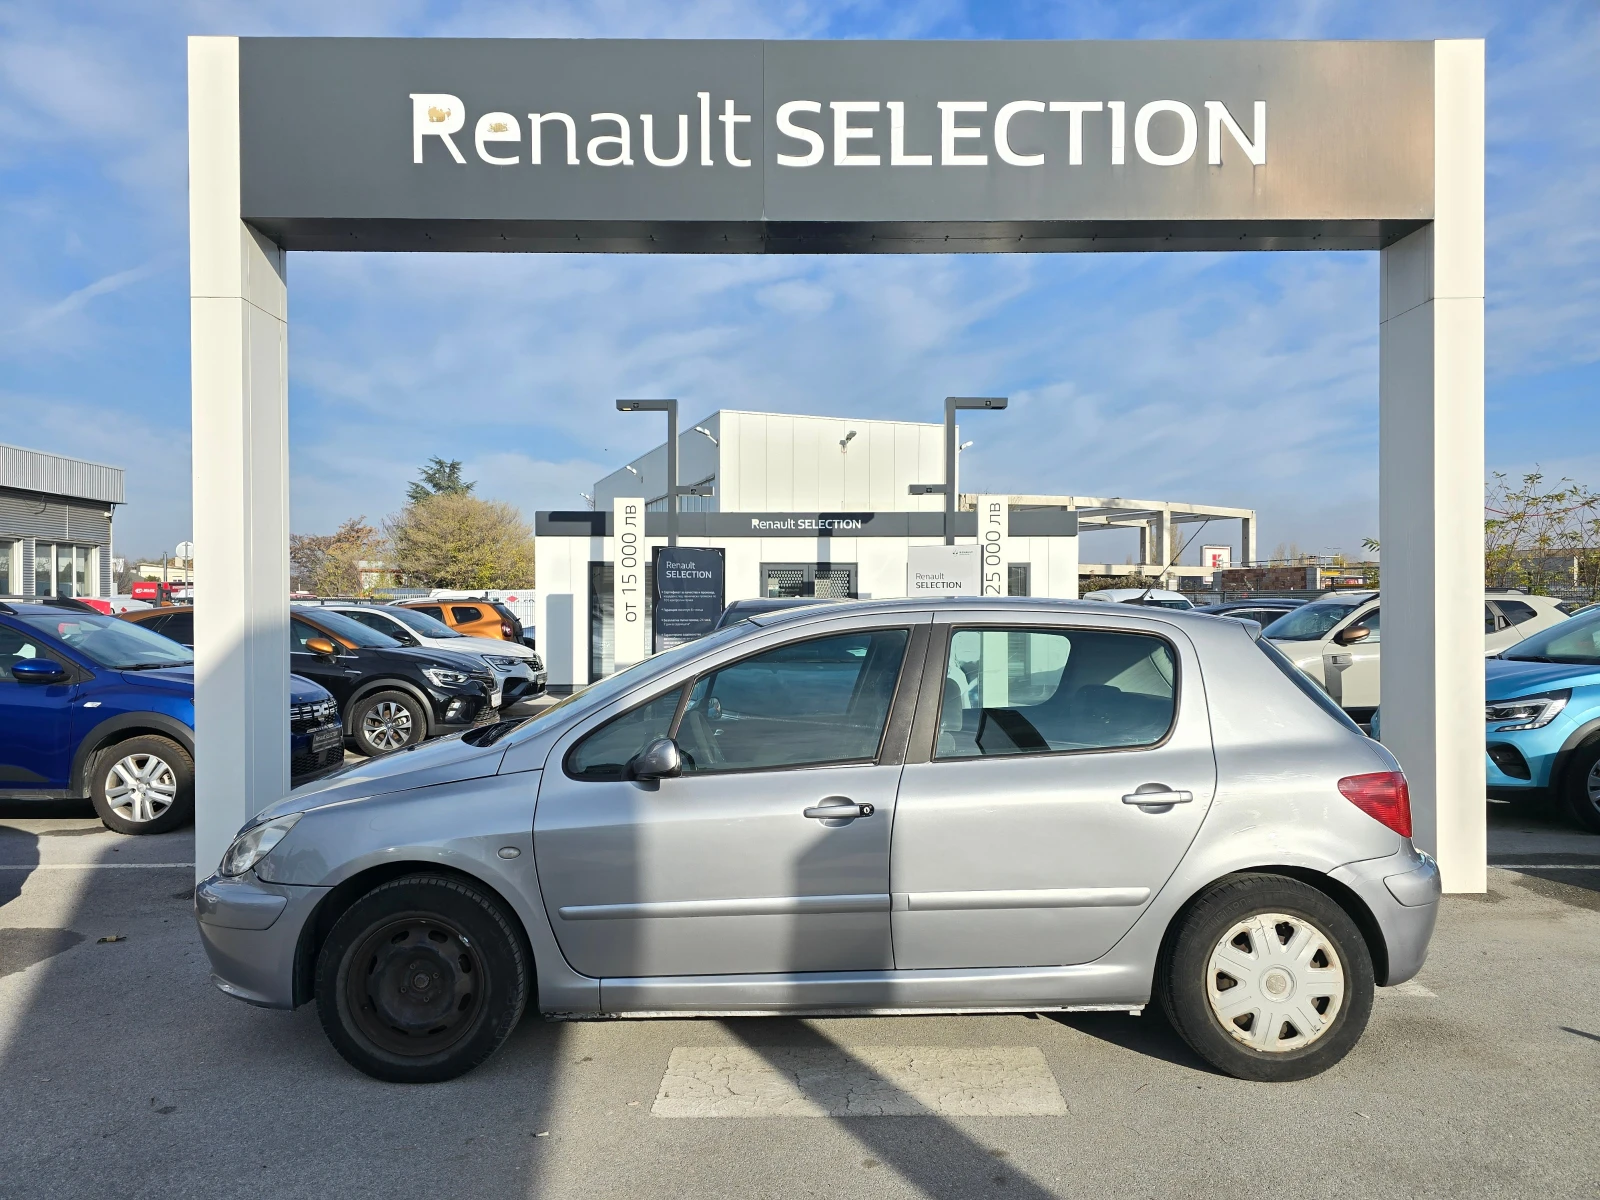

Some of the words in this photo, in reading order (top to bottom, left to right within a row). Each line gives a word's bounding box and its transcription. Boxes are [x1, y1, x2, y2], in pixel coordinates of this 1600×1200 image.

[409, 91, 751, 167] Renault
[775, 100, 1266, 167] SELECTION
[751, 518, 796, 529] Renault
[797, 519, 862, 529] SELECTION
[622, 533, 637, 568] 000
[985, 530, 1001, 566] 000
[666, 561, 696, 570] Renault
[666, 570, 712, 579] SELECTION
[915, 572, 945, 580] Renault
[622, 574, 637, 595] 15
[915, 581, 962, 589] SELECTION
[985, 572, 1001, 595] 25
